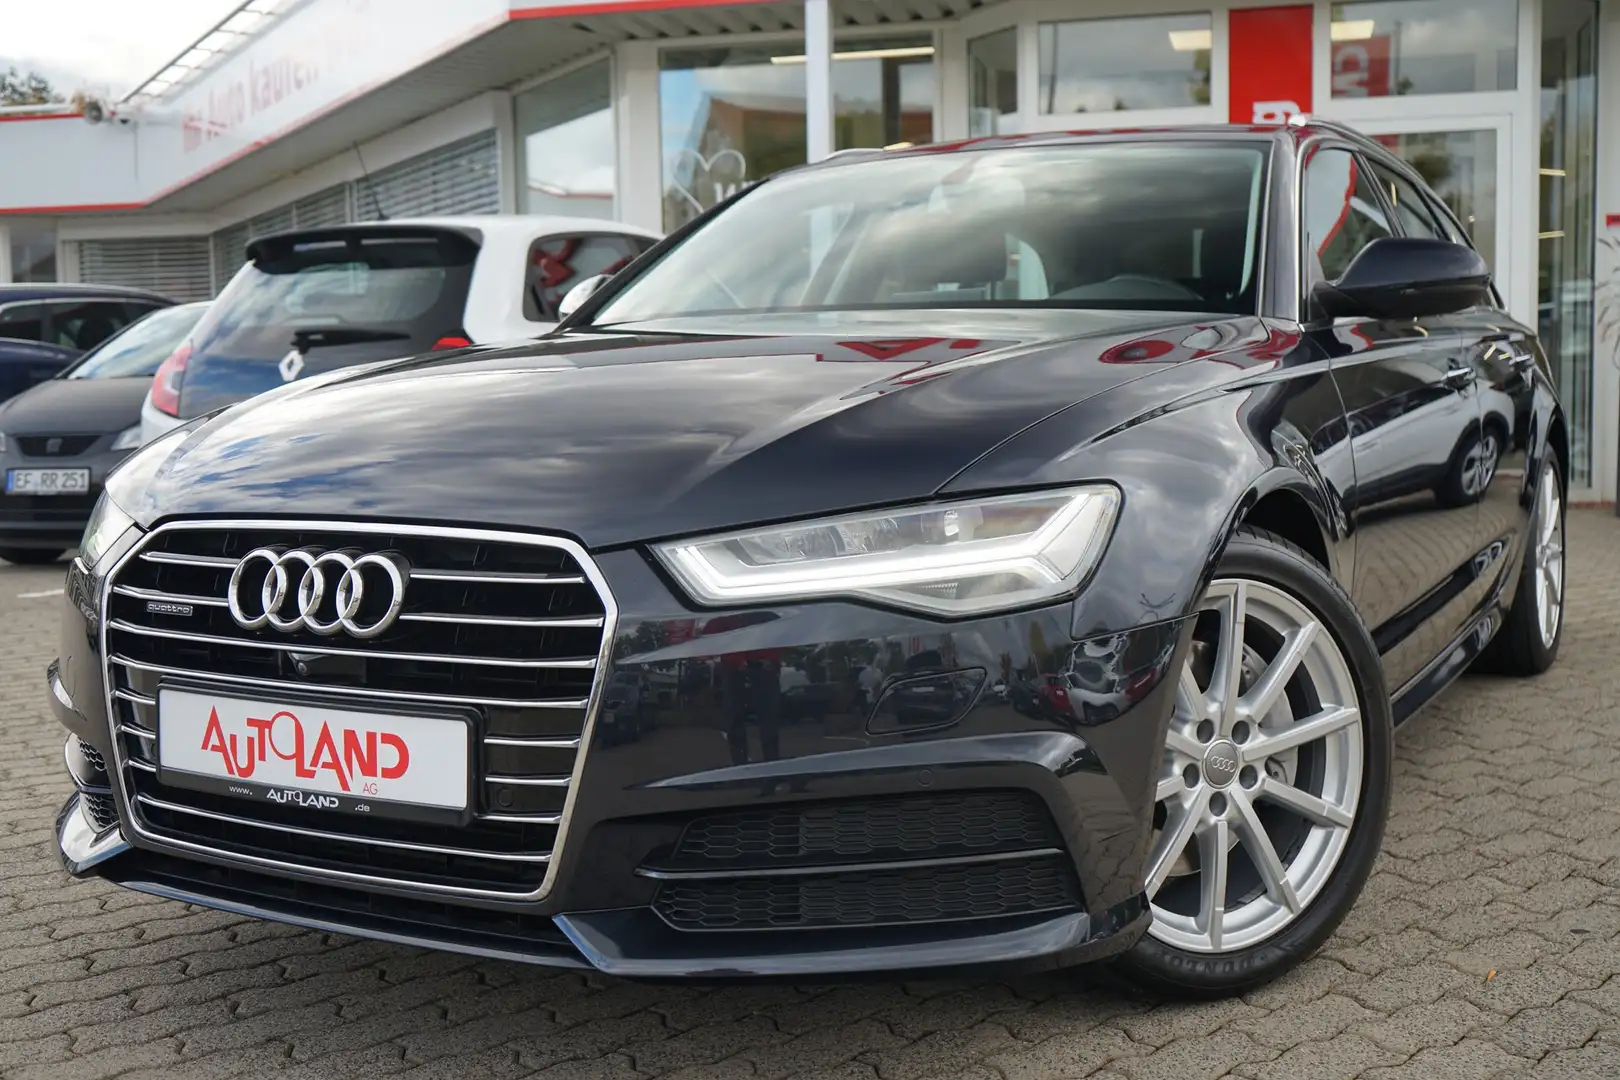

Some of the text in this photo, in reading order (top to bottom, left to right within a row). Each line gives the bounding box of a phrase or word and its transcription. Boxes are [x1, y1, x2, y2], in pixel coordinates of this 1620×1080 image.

[15, 472, 86, 488] EF RR 251
[147, 603, 190, 614] quattro
[201, 704, 410, 792] AUTOLAND
[363, 782, 379, 795] AG
[229, 785, 253, 796] www.
[266, 788, 339, 809] AUTOLAND
